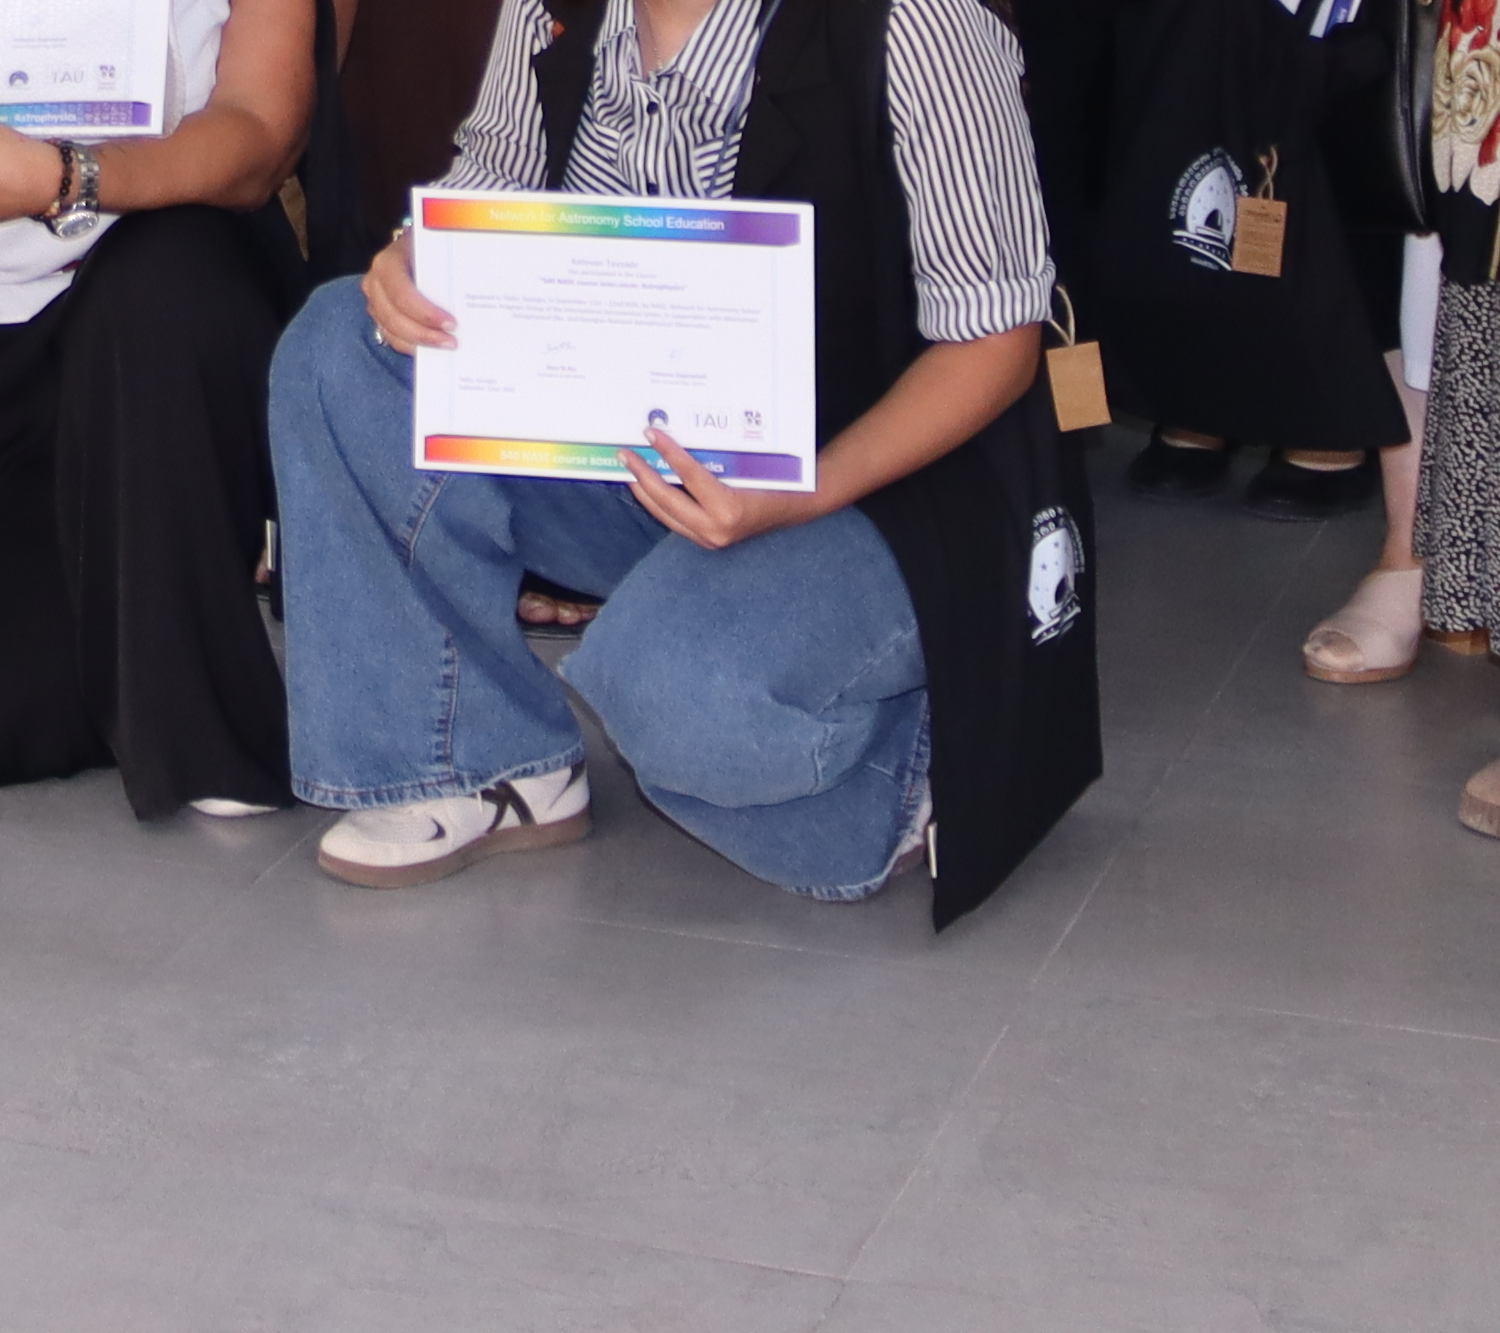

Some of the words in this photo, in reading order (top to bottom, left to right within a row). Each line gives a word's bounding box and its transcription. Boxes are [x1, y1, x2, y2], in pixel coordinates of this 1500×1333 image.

[489, 208, 536, 223] Network
[558, 211, 620, 229] Astronomy
[623, 213, 664, 229] School
[666, 215, 725, 232] Education
[695, 413, 729, 430] IAU
[553, 454, 588, 466] course
